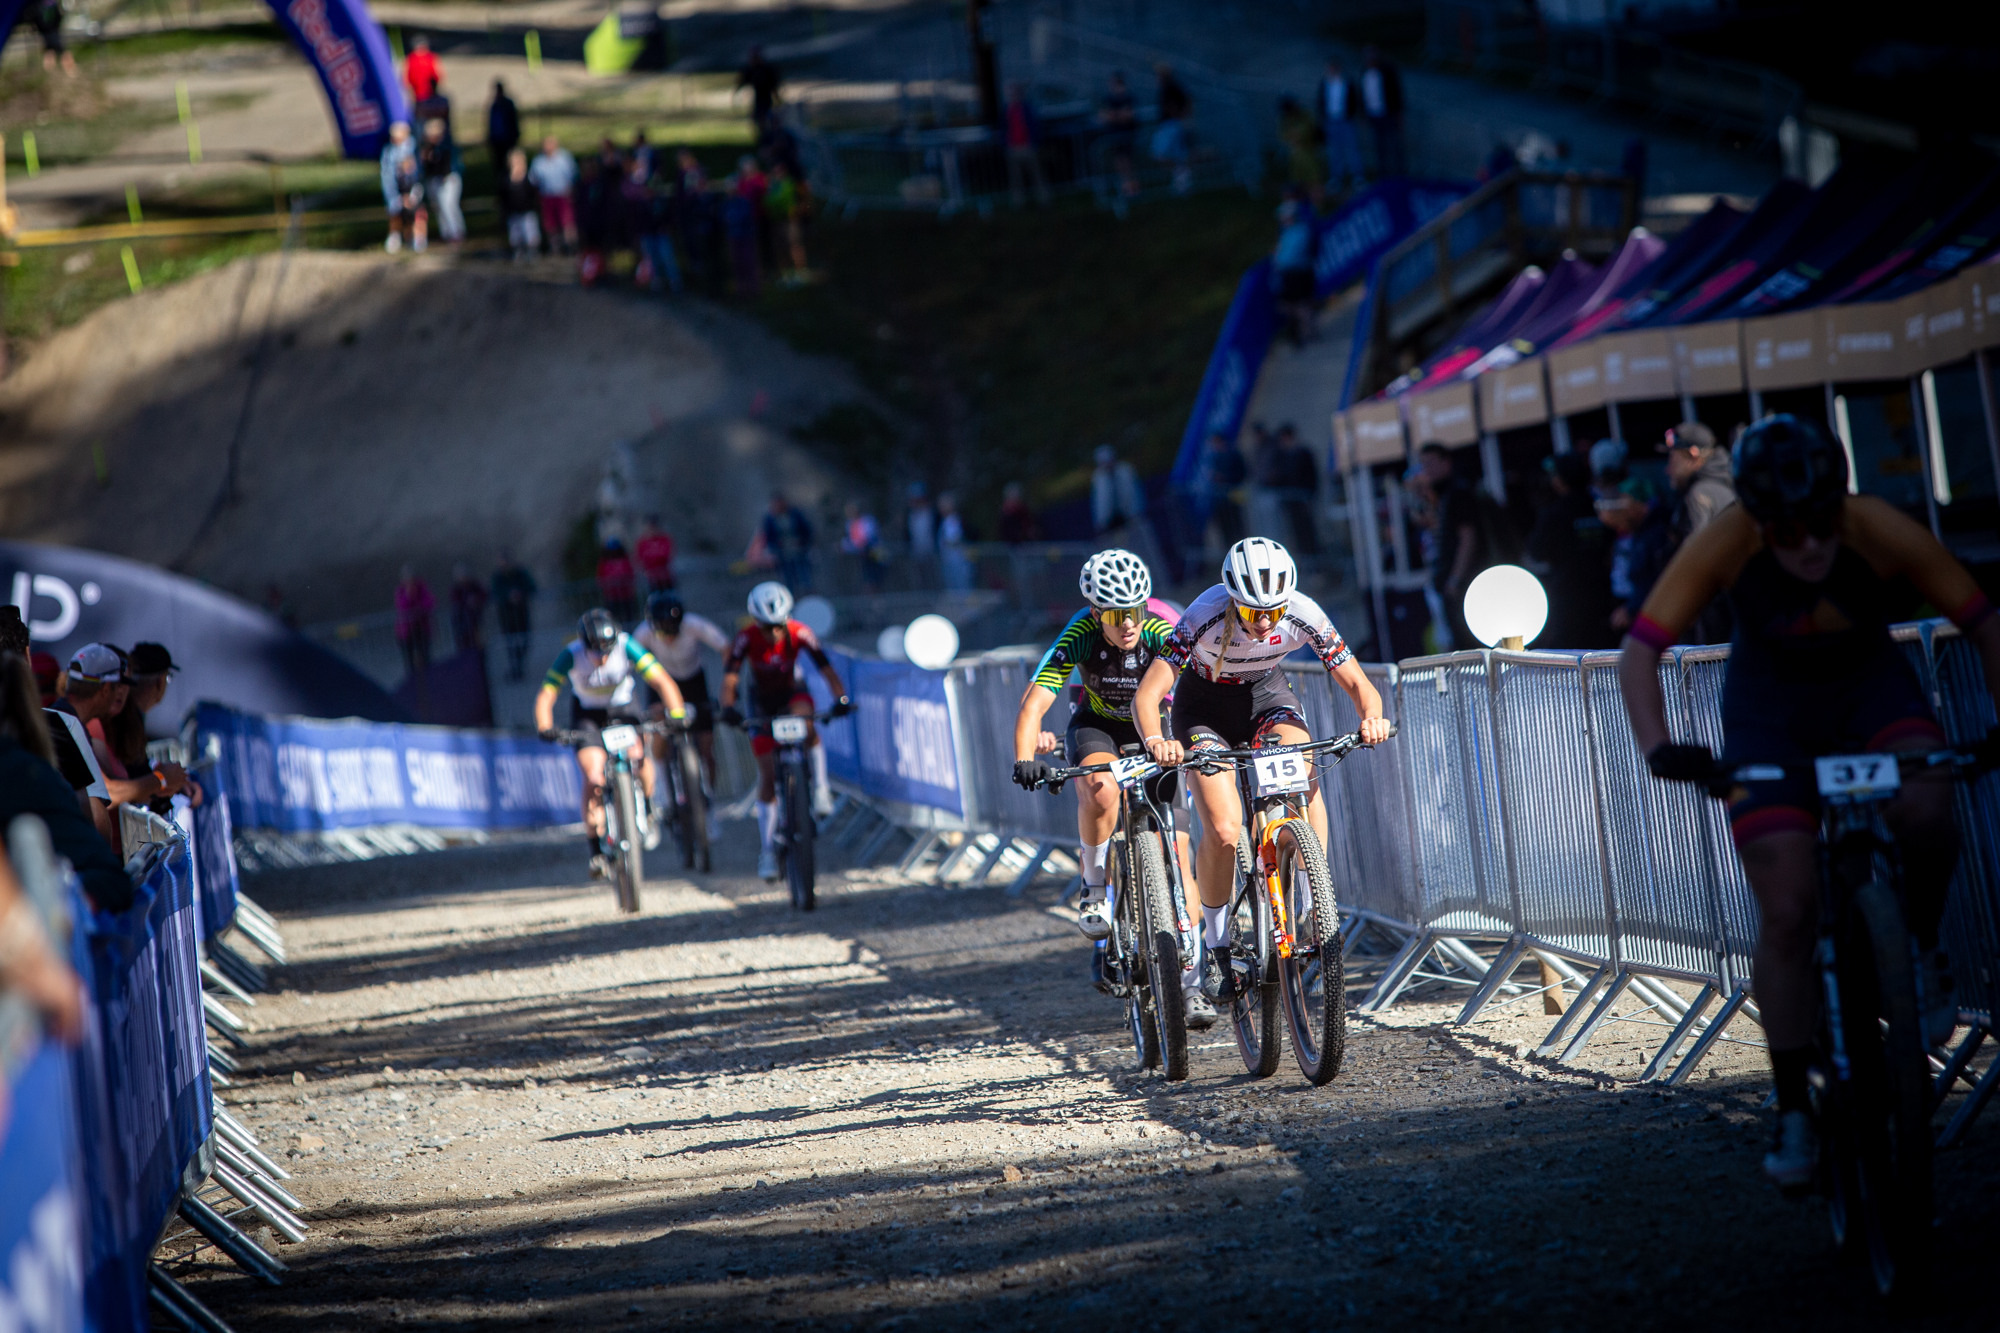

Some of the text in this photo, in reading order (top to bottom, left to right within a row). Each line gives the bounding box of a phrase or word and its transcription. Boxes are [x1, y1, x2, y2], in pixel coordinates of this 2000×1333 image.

[1260, 746, 1294, 756] WHOOP
[1119, 755, 1146, 774] 29
[1266, 759, 1297, 779] 15
[1832, 763, 1880, 785] 37
